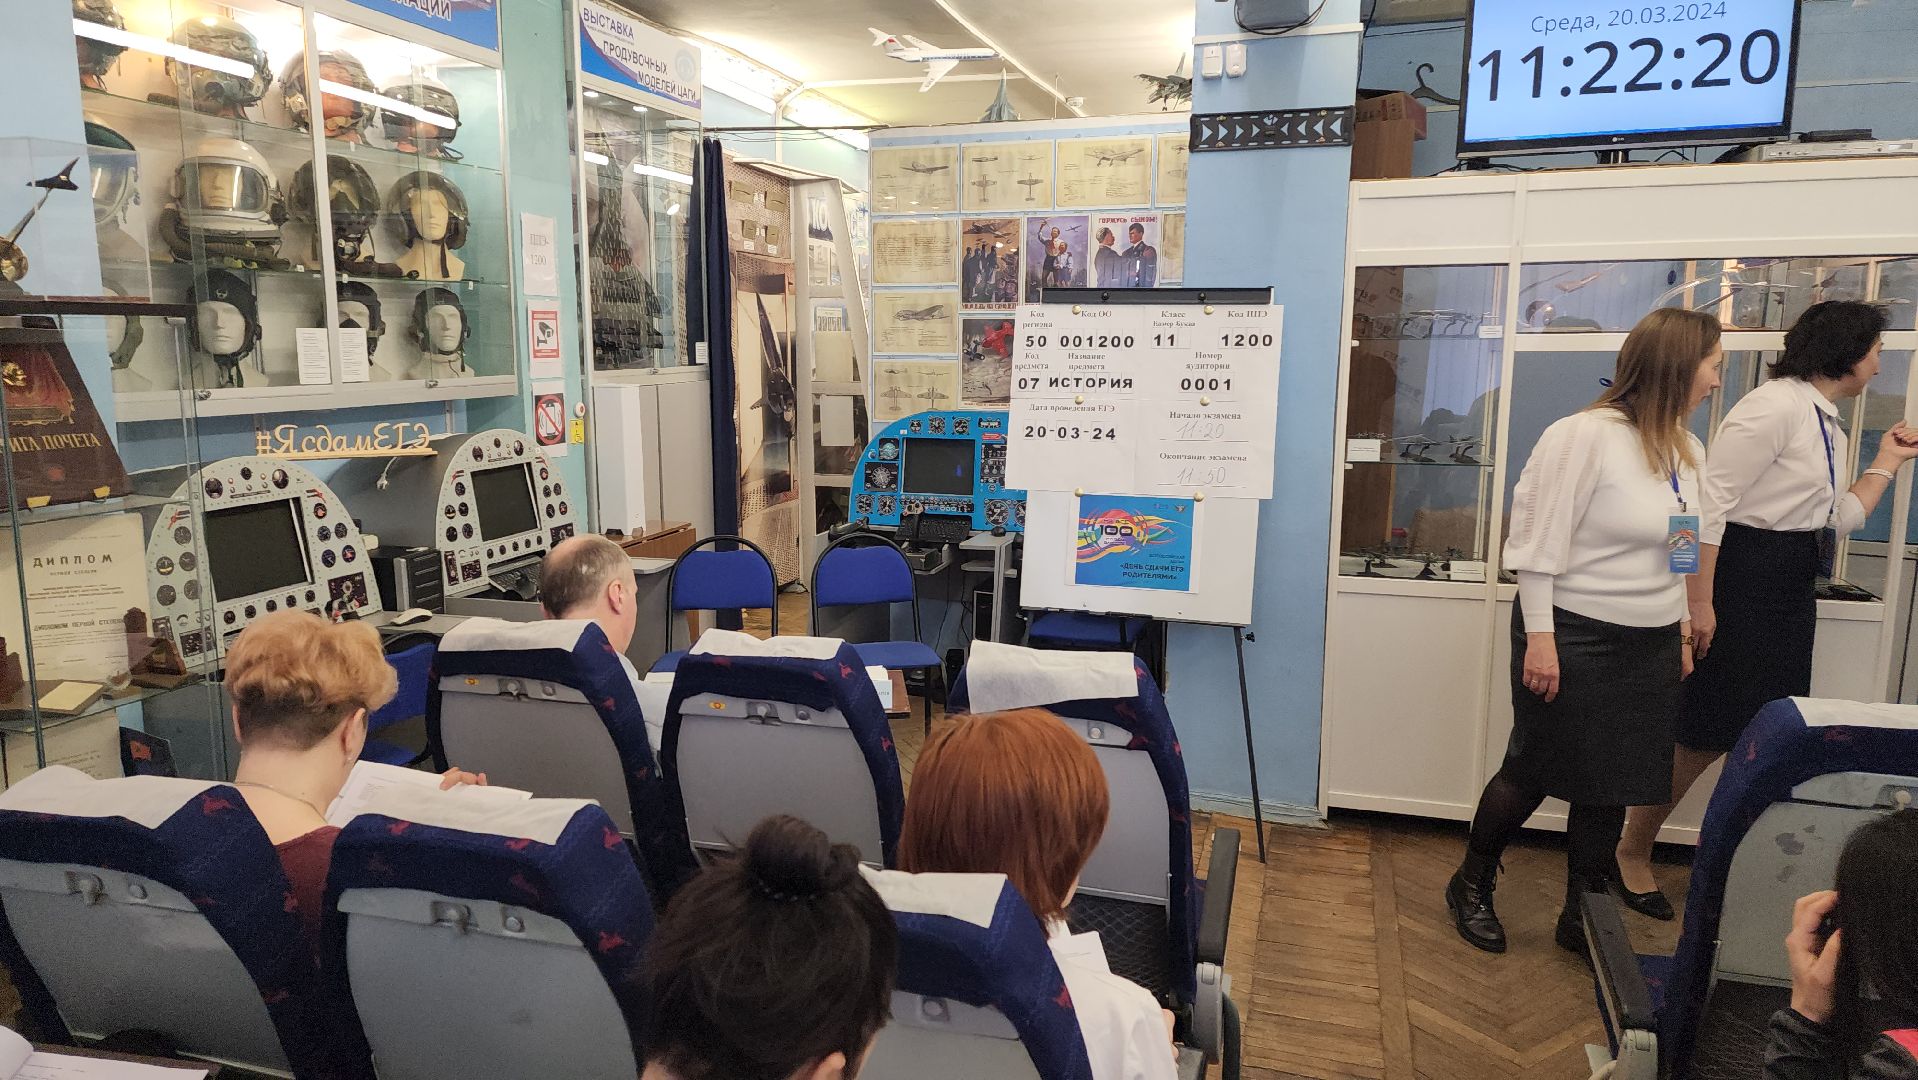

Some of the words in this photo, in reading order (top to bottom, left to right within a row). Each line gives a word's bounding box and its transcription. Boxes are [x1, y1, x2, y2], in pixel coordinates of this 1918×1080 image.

[583, 8, 635, 40] ВЫСТАВКА
[1531, 13, 1600, 36] Среда,
[1607, 1, 1727, 26] 20.03.2024
[603, 41, 668, 75] ПРОДУВОЧНЫХ
[1478, 28, 1780, 101] 11:22:20
[638, 71, 676, 94] МОДЕЛЕЙ
[677, 86, 696, 101] ЦАГИ
[1030, 310, 1045, 318] Код
[1081, 310, 1096, 318] Код
[1161, 310, 1186, 318] Класс
[1227, 310, 1244, 318] Код
[1022, 321, 1053, 329] региона
[1025, 335, 1047, 348] 50
[1060, 335, 1134, 348] 001200
[1153, 333, 1175, 347] 11
[1221, 333, 1273, 347] 1200
[1025, 352, 1040, 360] Код
[1068, 352, 1106, 360] Название
[1195, 351, 1223, 361] Номер
[1014, 363, 1049, 371] предмета
[1068, 363, 1105, 371] предмета
[1186, 362, 1231, 371] аудитории
[1018, 377, 1040, 390] 07
[1049, 377, 1133, 389] ИСТОРИЯ
[1181, 378, 1231, 391] 0001
[1029, 403, 1048, 412] Дата
[1050, 404, 1096, 413] проведения
[1169, 411, 1201, 419] Начало
[1203, 412, 1242, 420] экзамена
[1024, 425, 1117, 441] 20-03-24
[42, 433, 102, 450] ПОЧЕТА
[1159, 452, 1206, 461] Окончание
[1208, 454, 1248, 462] экзамена
[1099, 524, 1134, 537] 100
[33, 554, 113, 568] ДИПЛОМ
[1145, 564, 1170, 572] СДАЧИ
[1171, 565, 1185, 573] ЕГЭ
